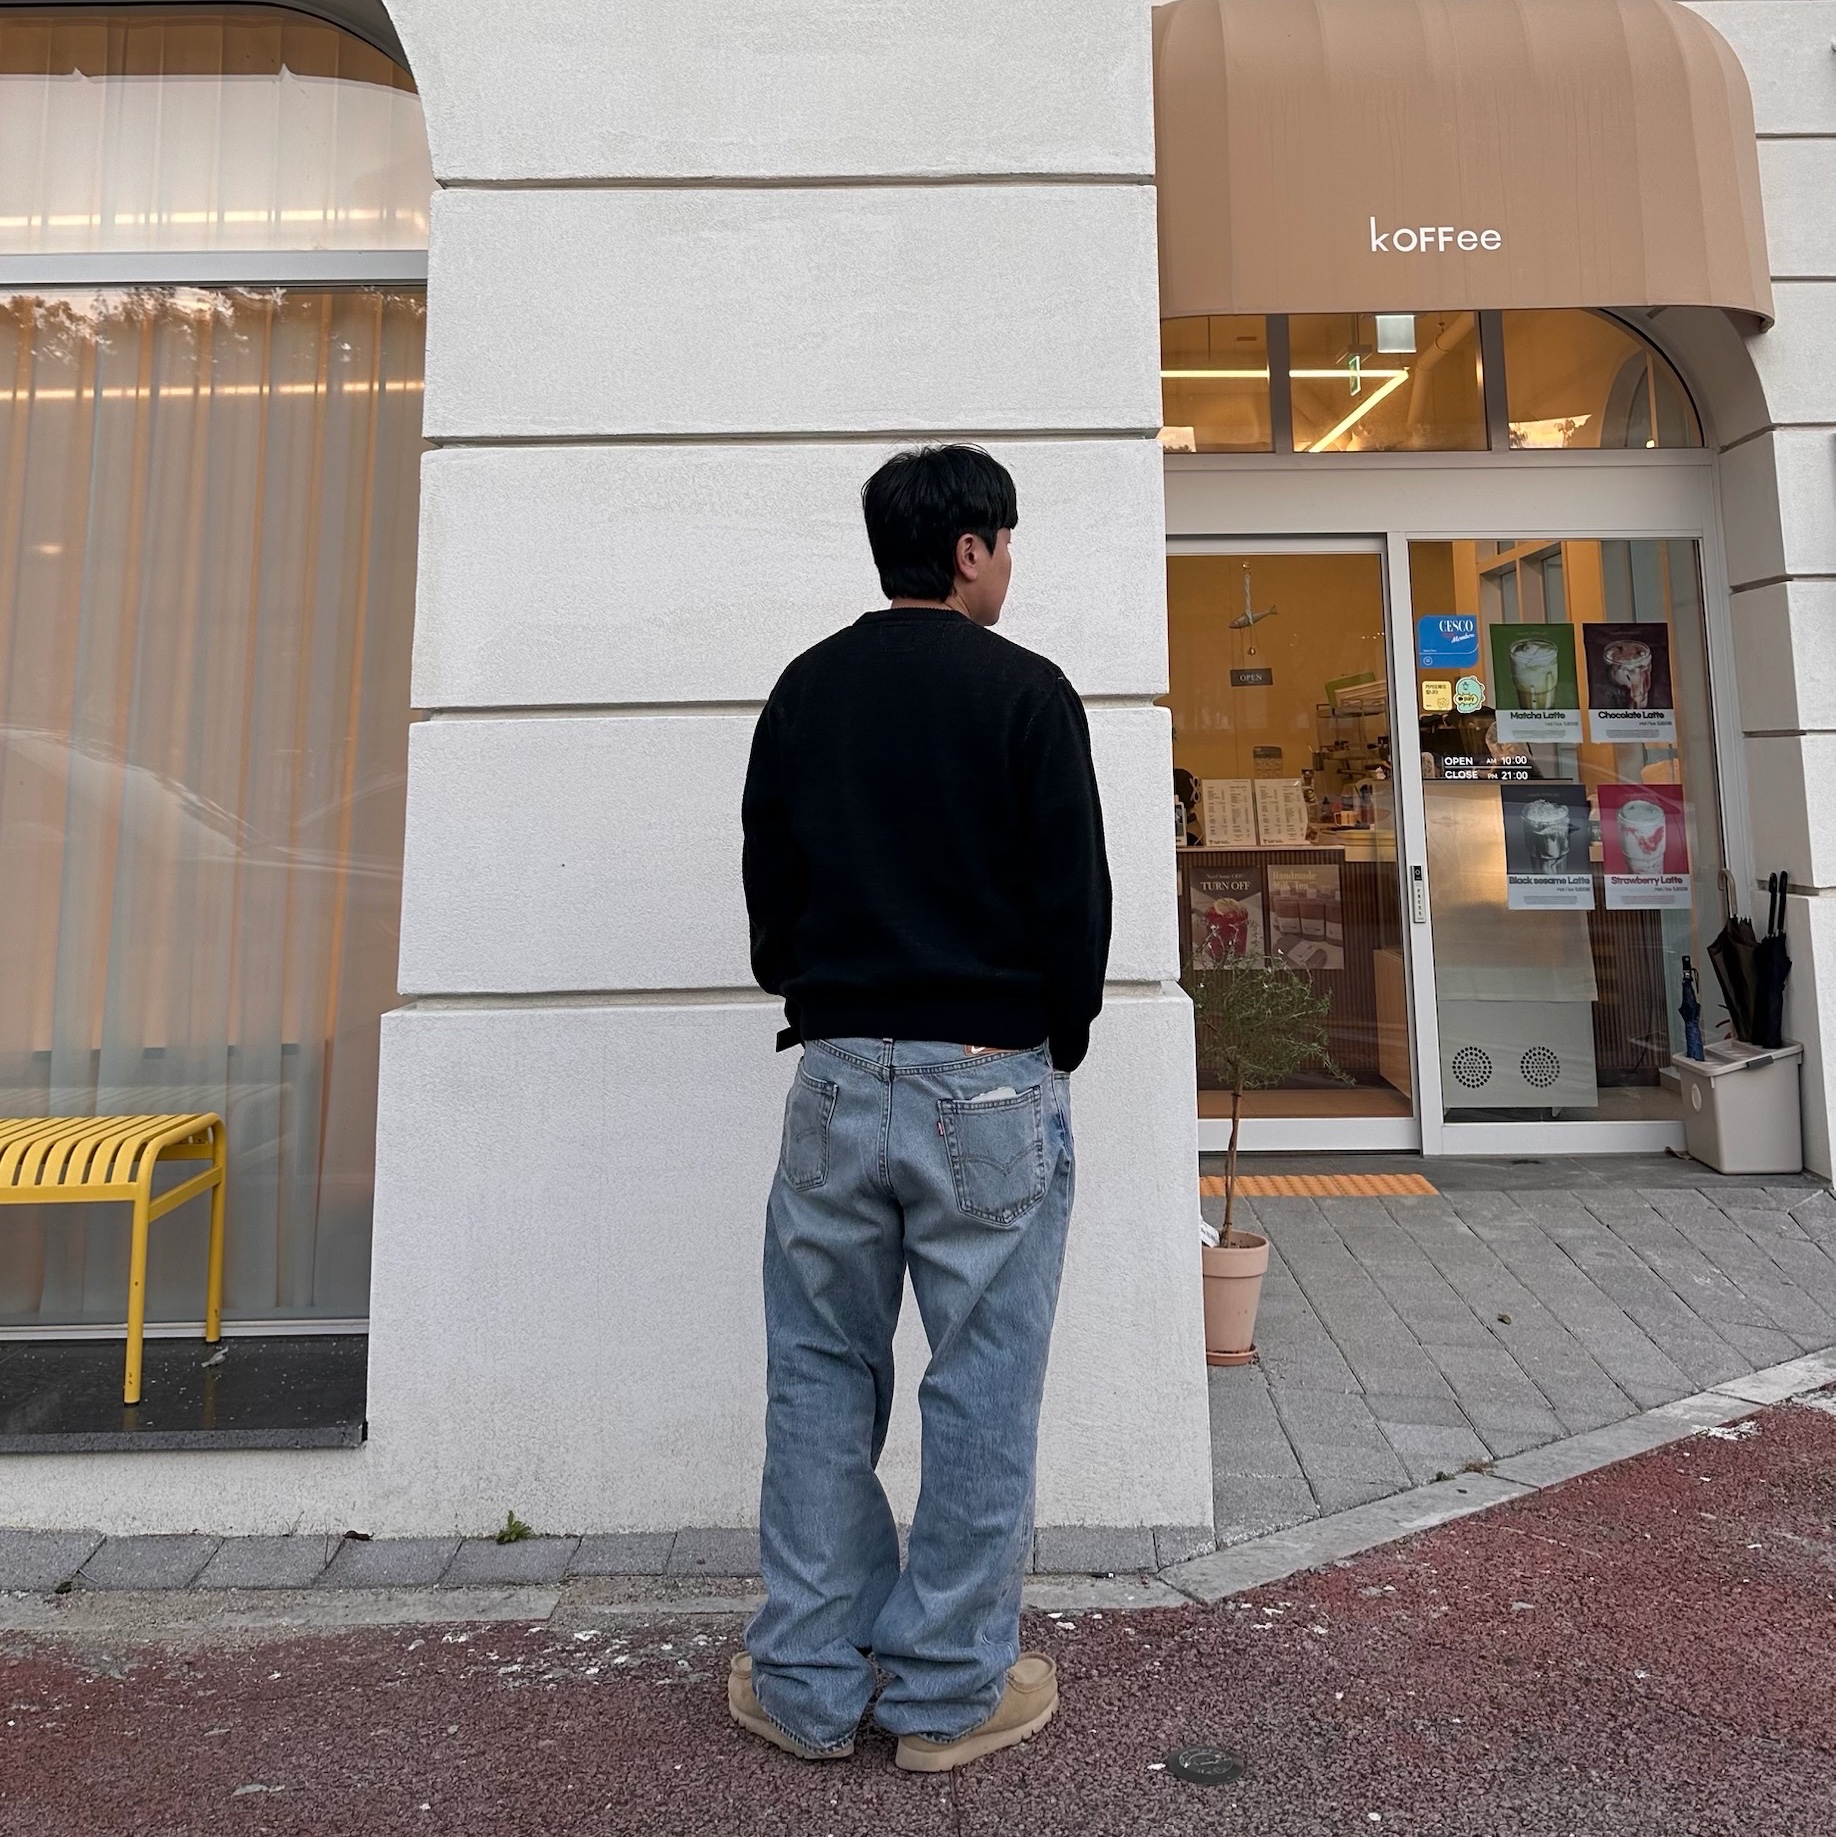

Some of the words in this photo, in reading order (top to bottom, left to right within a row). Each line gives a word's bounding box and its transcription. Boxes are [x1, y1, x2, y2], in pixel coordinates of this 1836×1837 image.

[1439, 619, 1474, 632] CESCO
[1239, 673, 1263, 682] OPEN
[1510, 711, 1542, 719] Matcha
[1543, 711, 1566, 719] Latte
[1598, 711, 1642, 719] Chocolate
[1643, 711, 1665, 719] Latte
[1444, 756, 1474, 766] OPEN
[1501, 755, 1528, 765] 10:00
[1444, 770, 1479, 779] CLOSE
[1501, 771, 1529, 780] 21:00
[1508, 876, 1533, 884] Black
[1567, 876, 1590, 884] Latte
[1611, 876, 1660, 886] Strawberry
[1660, 876, 1683, 884] Latte
[1200, 881, 1230, 890] TURN
[1230, 881, 1251, 890] OFF
